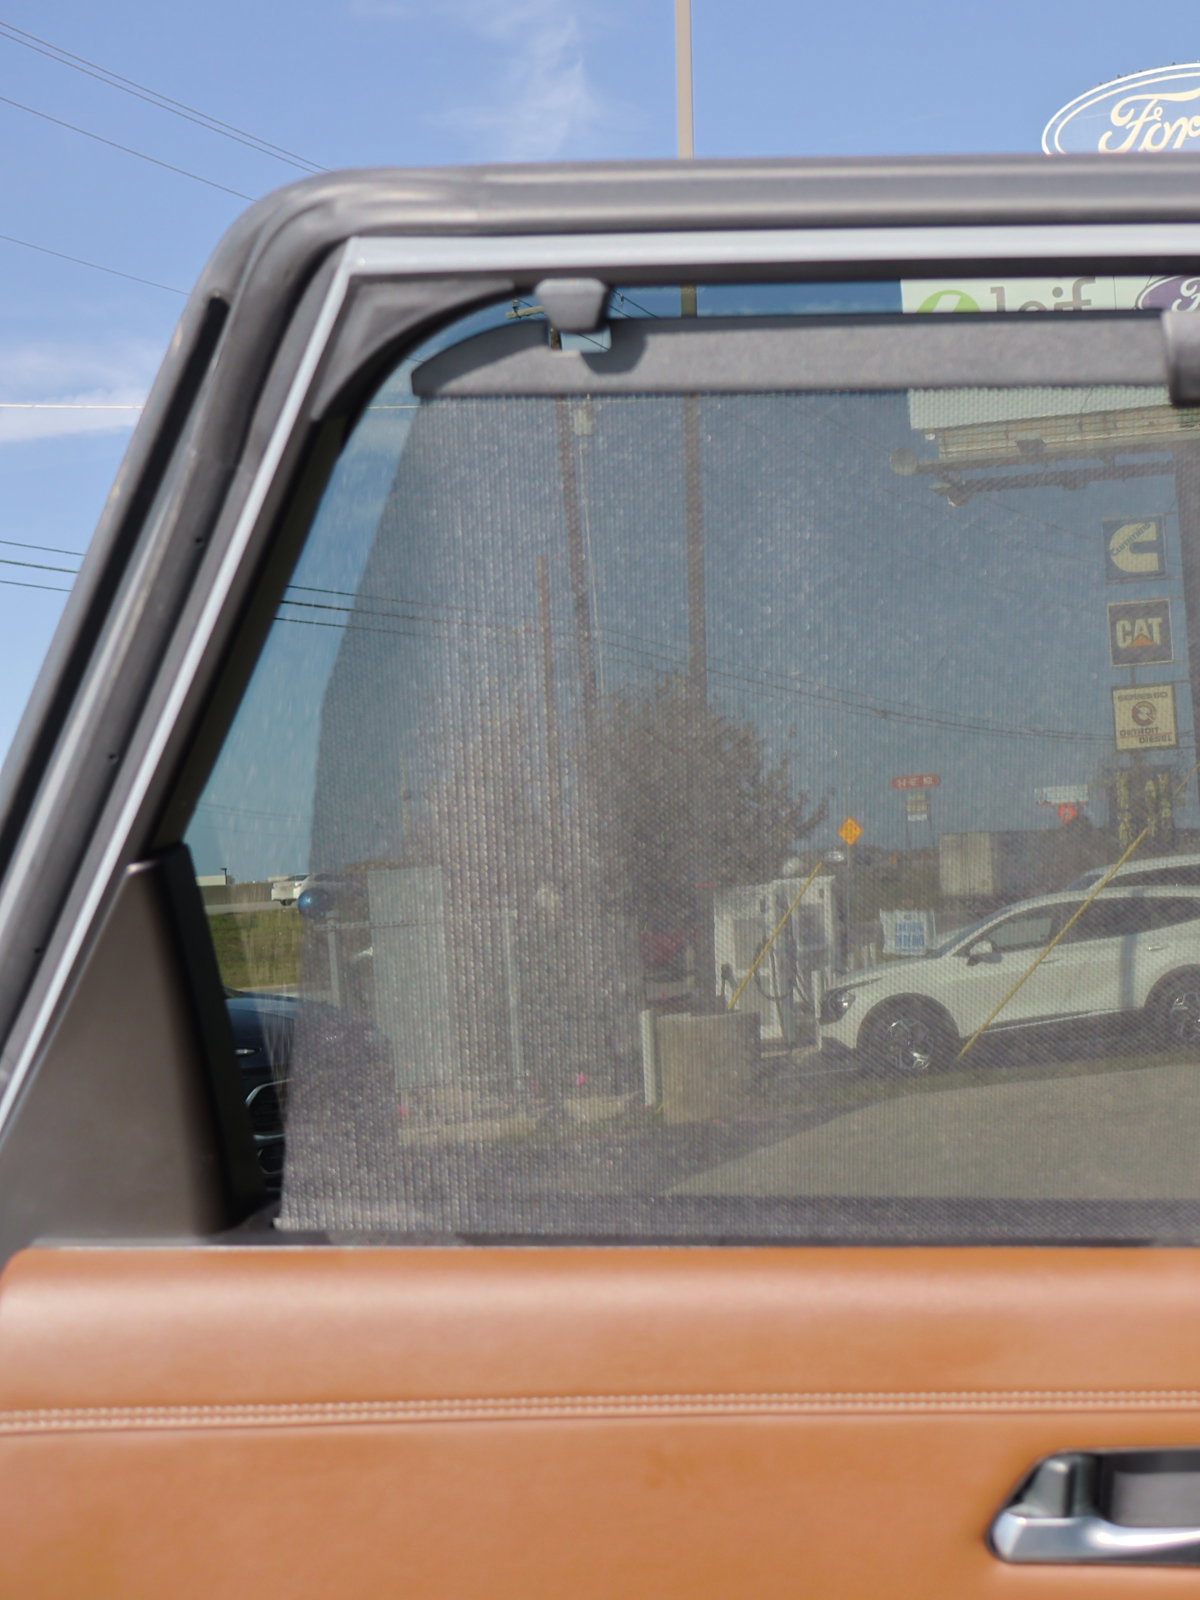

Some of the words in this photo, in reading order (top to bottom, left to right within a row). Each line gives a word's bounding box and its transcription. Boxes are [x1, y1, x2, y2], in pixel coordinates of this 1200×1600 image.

[1116, 617, 1163, 649] CAT
[1119, 726, 1159, 737] DETROIT
[1139, 735, 1172, 744] DIESEL
